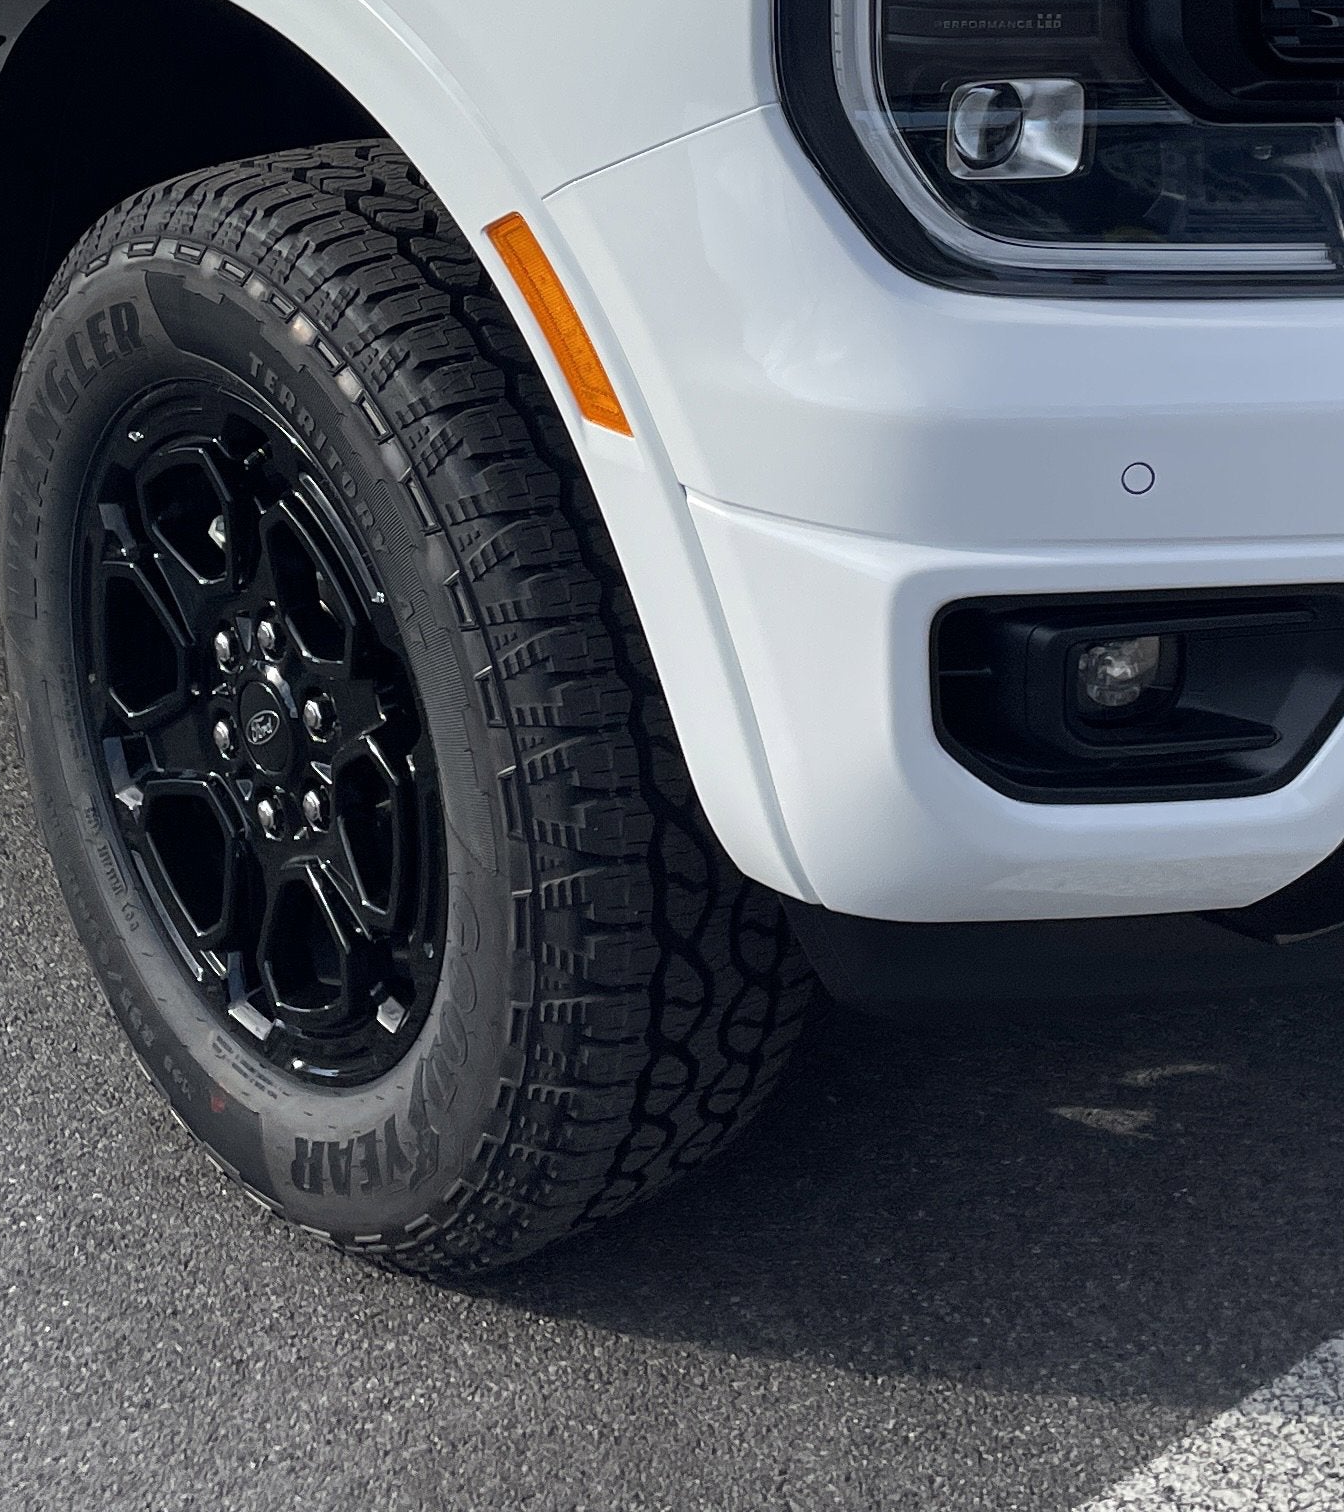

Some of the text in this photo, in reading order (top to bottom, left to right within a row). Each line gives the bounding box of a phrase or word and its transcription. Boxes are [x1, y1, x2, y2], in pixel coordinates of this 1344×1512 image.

[934, 19, 1063, 30] PERFORMANCE LED
[7, 300, 144, 621] WRANGLER
[248, 351, 392, 556] TERRITORY
[250, 715, 273, 743] Ford
